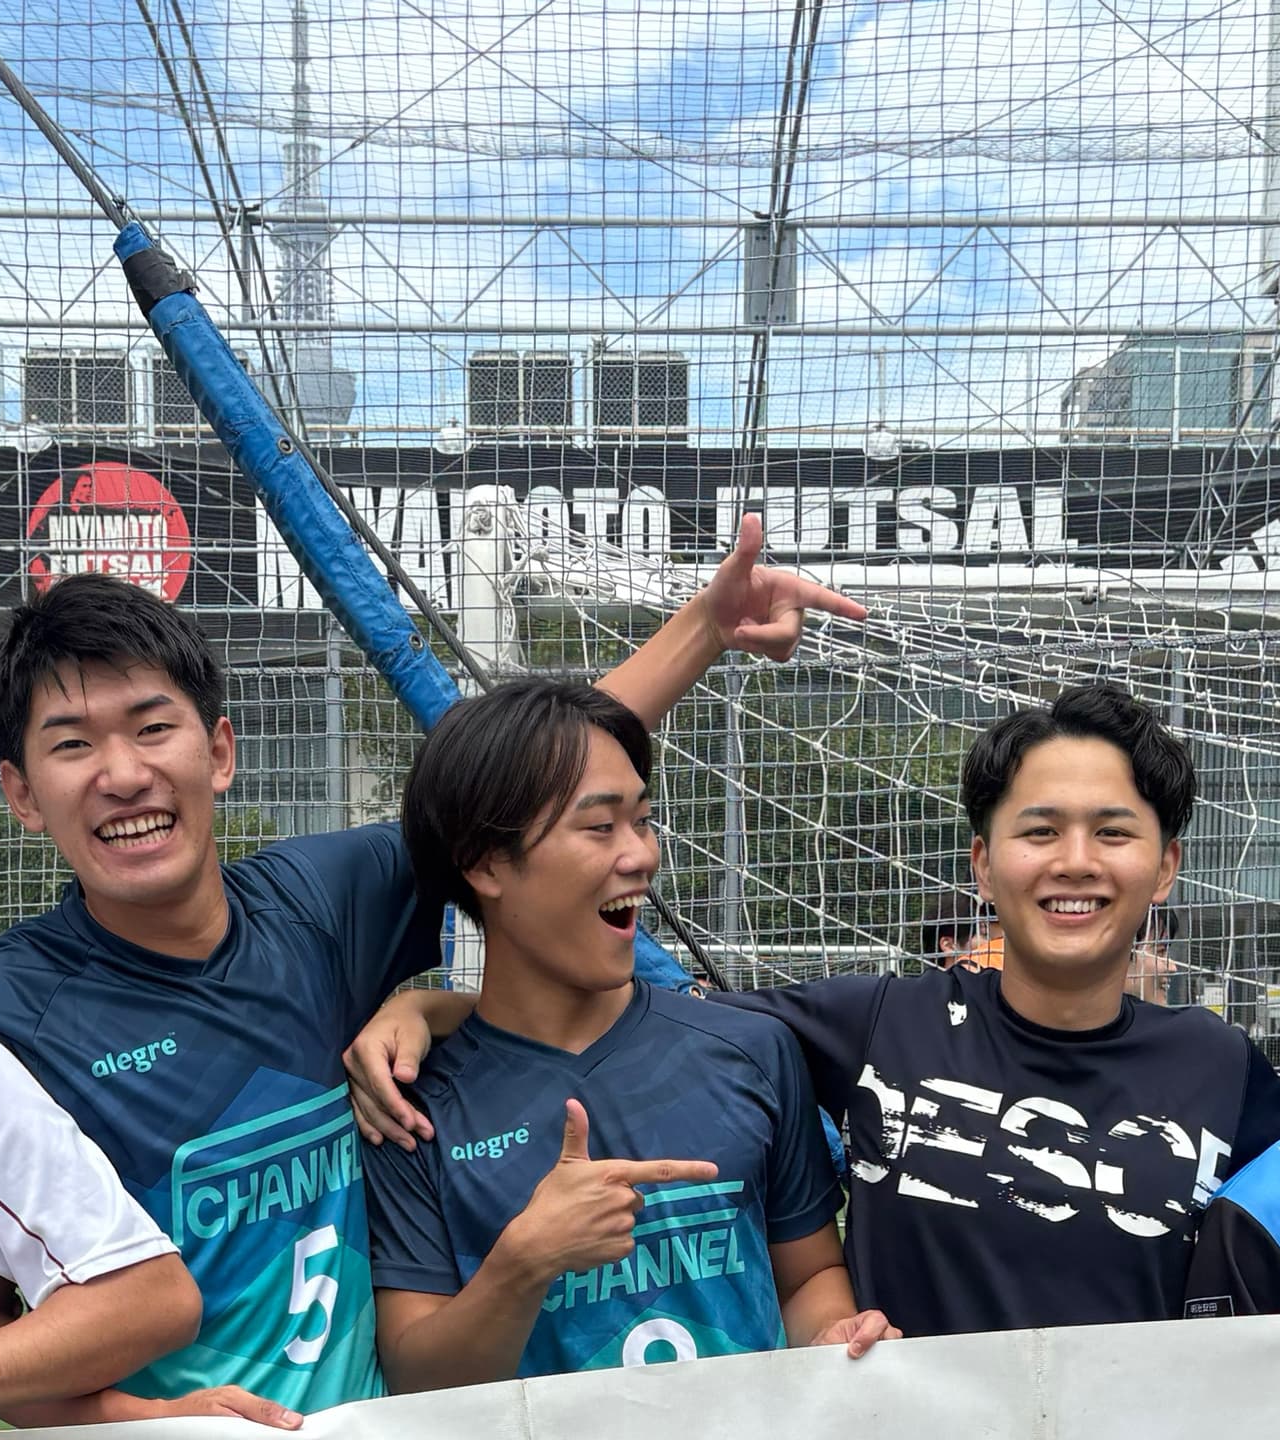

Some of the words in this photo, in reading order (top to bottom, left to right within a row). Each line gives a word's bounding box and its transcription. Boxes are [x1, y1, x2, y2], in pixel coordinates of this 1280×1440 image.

[48, 514, 168, 550] MIYAMOTO
[50, 554, 169, 578] FUTSAL
[91, 1036, 177, 1078] alegre
[451, 1127, 530, 1162] alegre
[283, 1224, 339, 1364] 5
